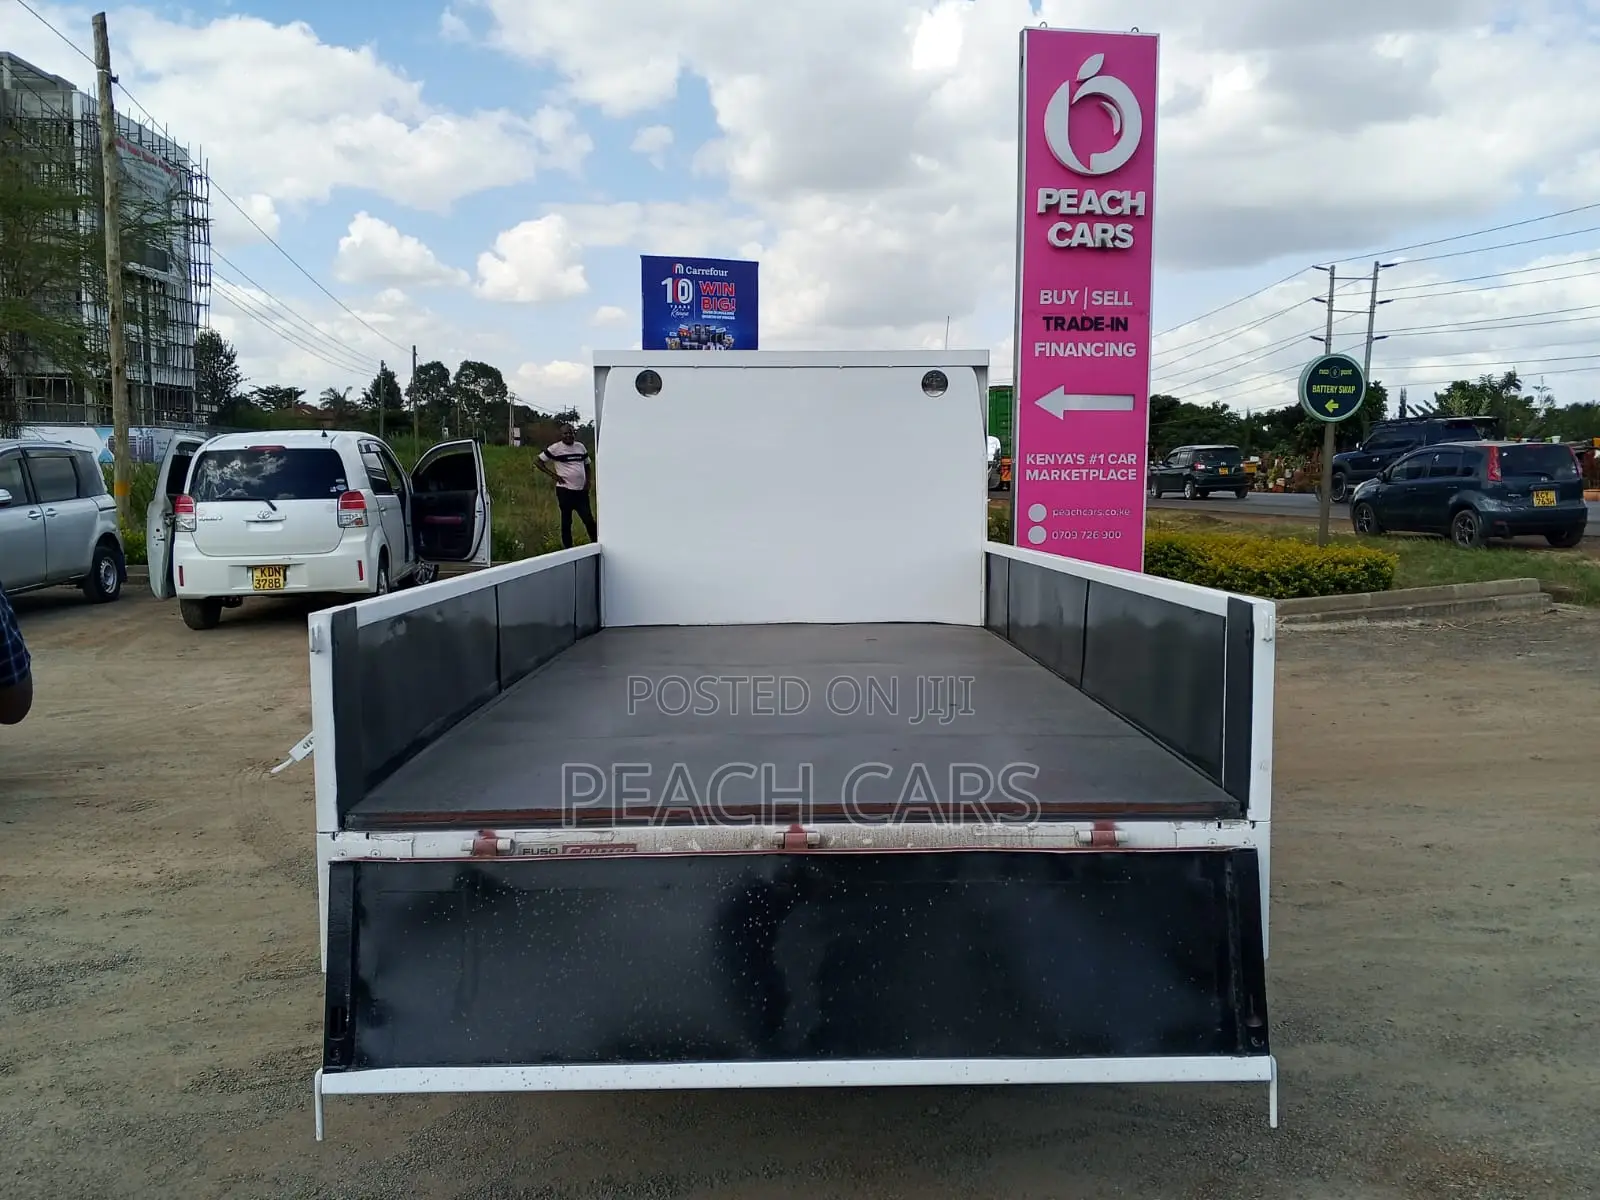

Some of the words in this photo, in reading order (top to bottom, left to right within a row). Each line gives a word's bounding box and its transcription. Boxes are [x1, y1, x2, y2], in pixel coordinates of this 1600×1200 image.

[1037, 187, 1146, 216] PEACH
[1047, 221, 1134, 249] CARS
[686, 266, 728, 276] Carrefour
[661, 278, 693, 304] 10
[699, 281, 735, 296] WIN
[701, 297, 736, 312] BIG!
[1039, 289, 1079, 305] BUY
[1091, 290, 1133, 306] SELL
[1042, 316, 1128, 332] TRADE-IN
[1034, 342, 1137, 357] FINANCING
[1312, 384, 1338, 394] BATTERY
[1338, 385, 1356, 394] SWAP
[1026, 453, 1085, 465] KENYA'S
[1089, 454, 1105, 464] #1
[1108, 453, 1137, 465] CAR
[1025, 469, 1137, 481] MARKETPLACE
[260, 567, 281, 577] KDN
[255, 578, 281, 589] 378B
[522, 847, 558, 856] FUSO
